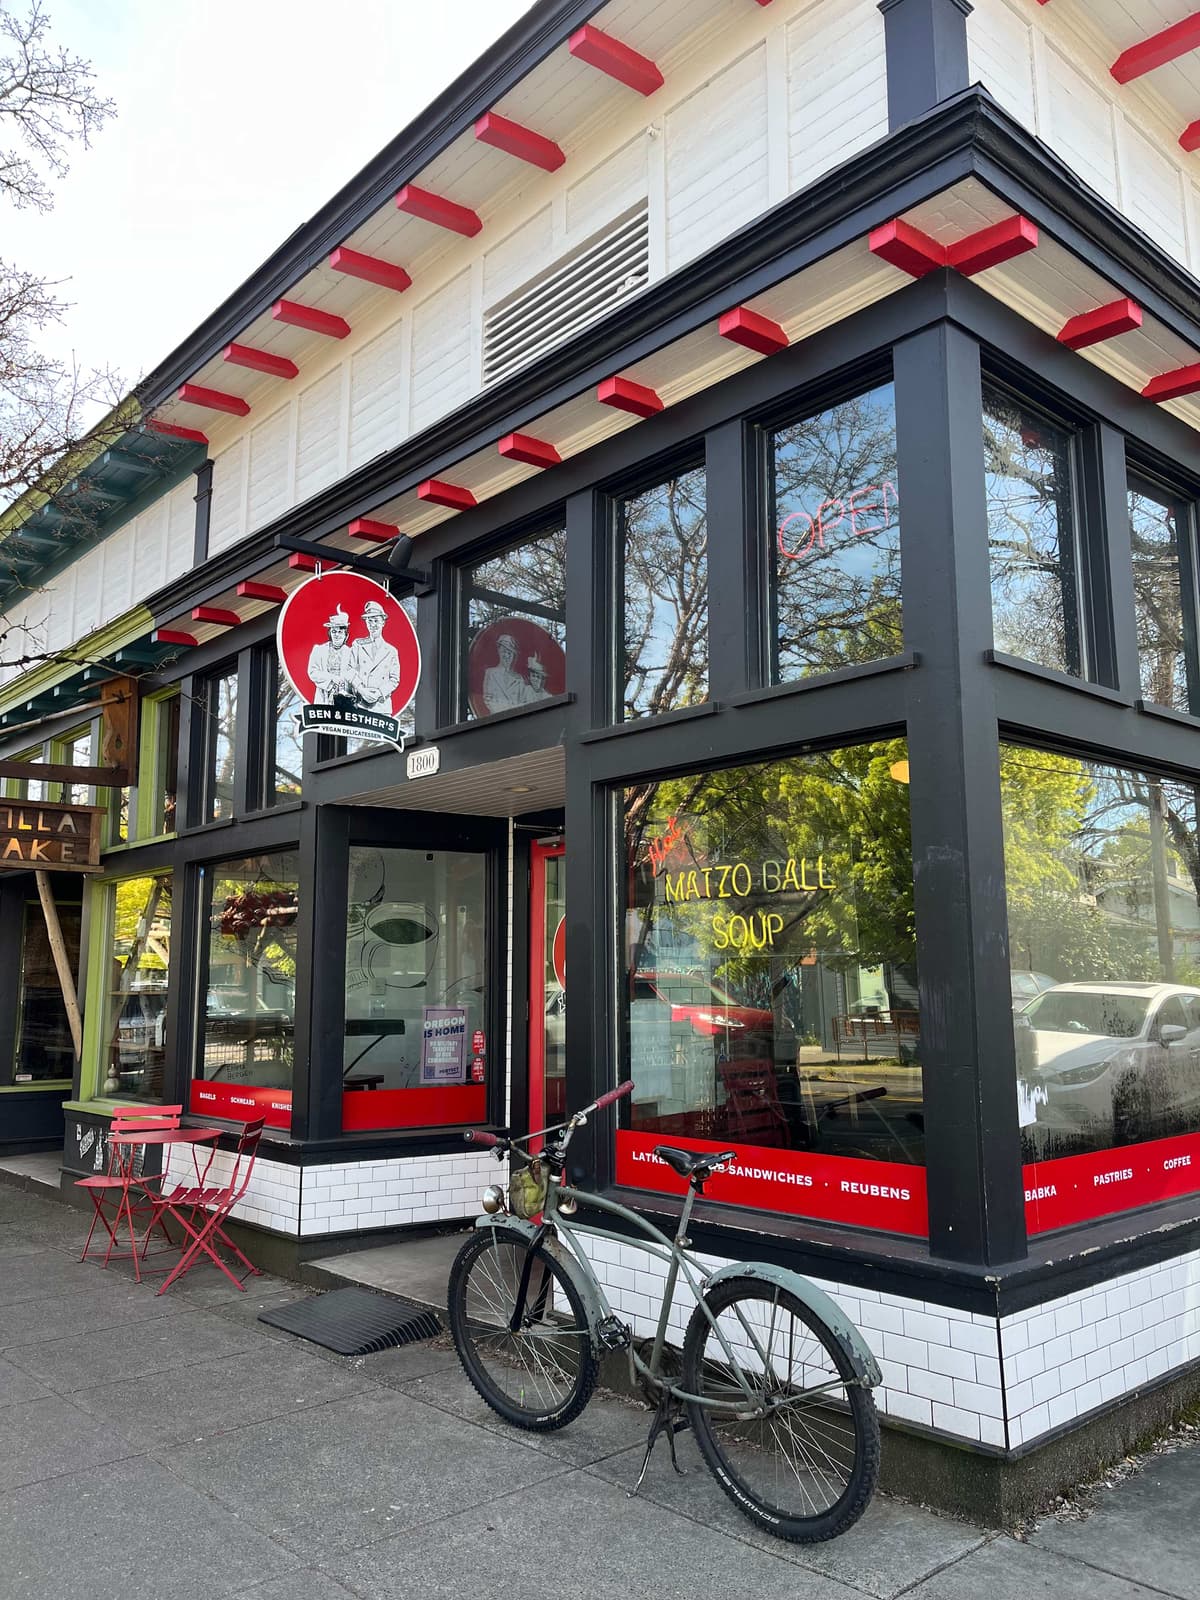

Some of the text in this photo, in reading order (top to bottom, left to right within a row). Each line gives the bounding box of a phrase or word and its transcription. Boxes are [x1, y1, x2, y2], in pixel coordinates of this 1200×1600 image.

[308, 710, 395, 732] BEN & ESTHER'S
[321, 725, 381, 738] VEGAN DELICATESSEN
[410, 753, 435, 772] 1800
[665, 855, 837, 902] MATZO BALL
[712, 914, 784, 948] SOUP
[423, 1025, 465, 1039] IS HOME
[424, 1016, 465, 1029] OREGON
[199, 1092, 216, 1101] BAGELS
[230, 1096, 254, 1106] SCHMEARS
[632, 1151, 669, 1166] LATKE
[728, 1165, 812, 1187] SANDWICHES
[840, 1181, 910, 1200] REUBENS
[1025, 1155, 1191, 1202] BABKA PASTRIES COFFEE
